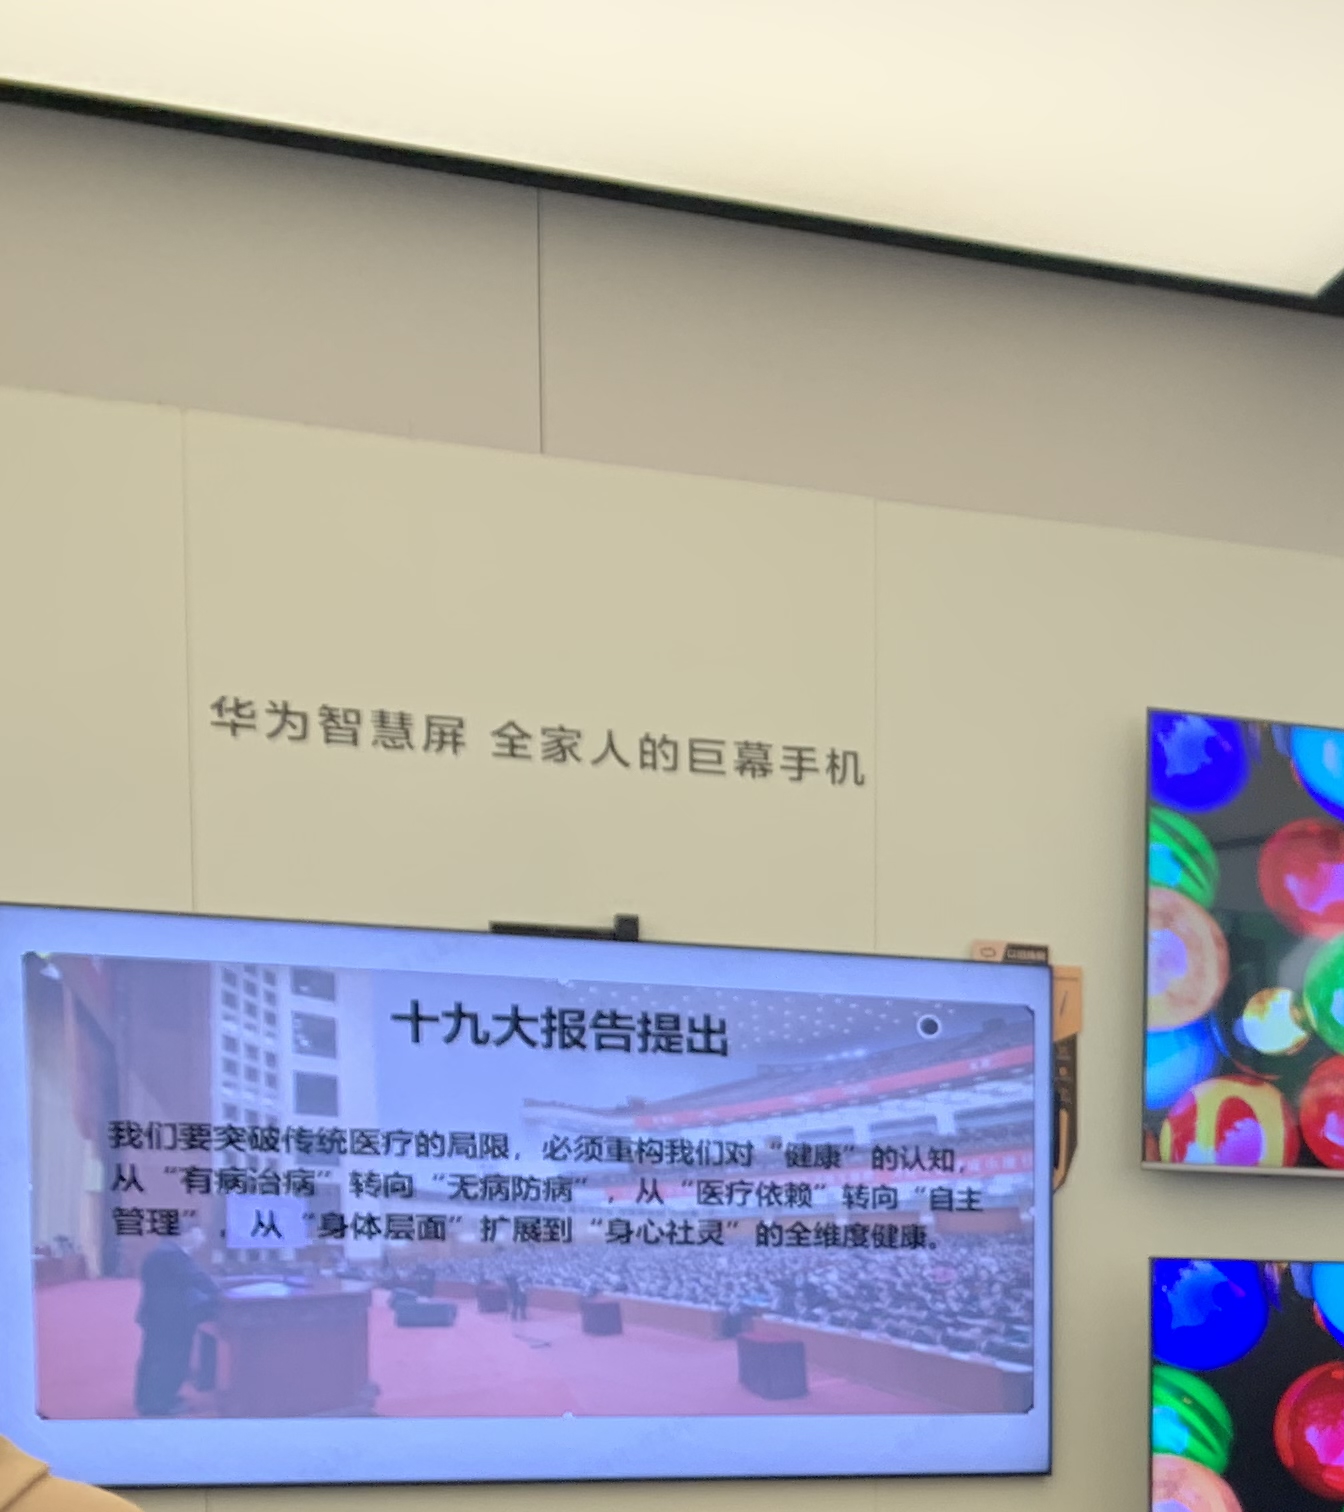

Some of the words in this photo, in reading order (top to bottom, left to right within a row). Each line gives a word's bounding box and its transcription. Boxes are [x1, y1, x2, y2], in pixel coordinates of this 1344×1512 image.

[210, 695, 467, 756] 华为智慧屏
[490, 720, 866, 788] 全家人的巨幕手机
[390, 999, 729, 1058] 十九大报告提出
